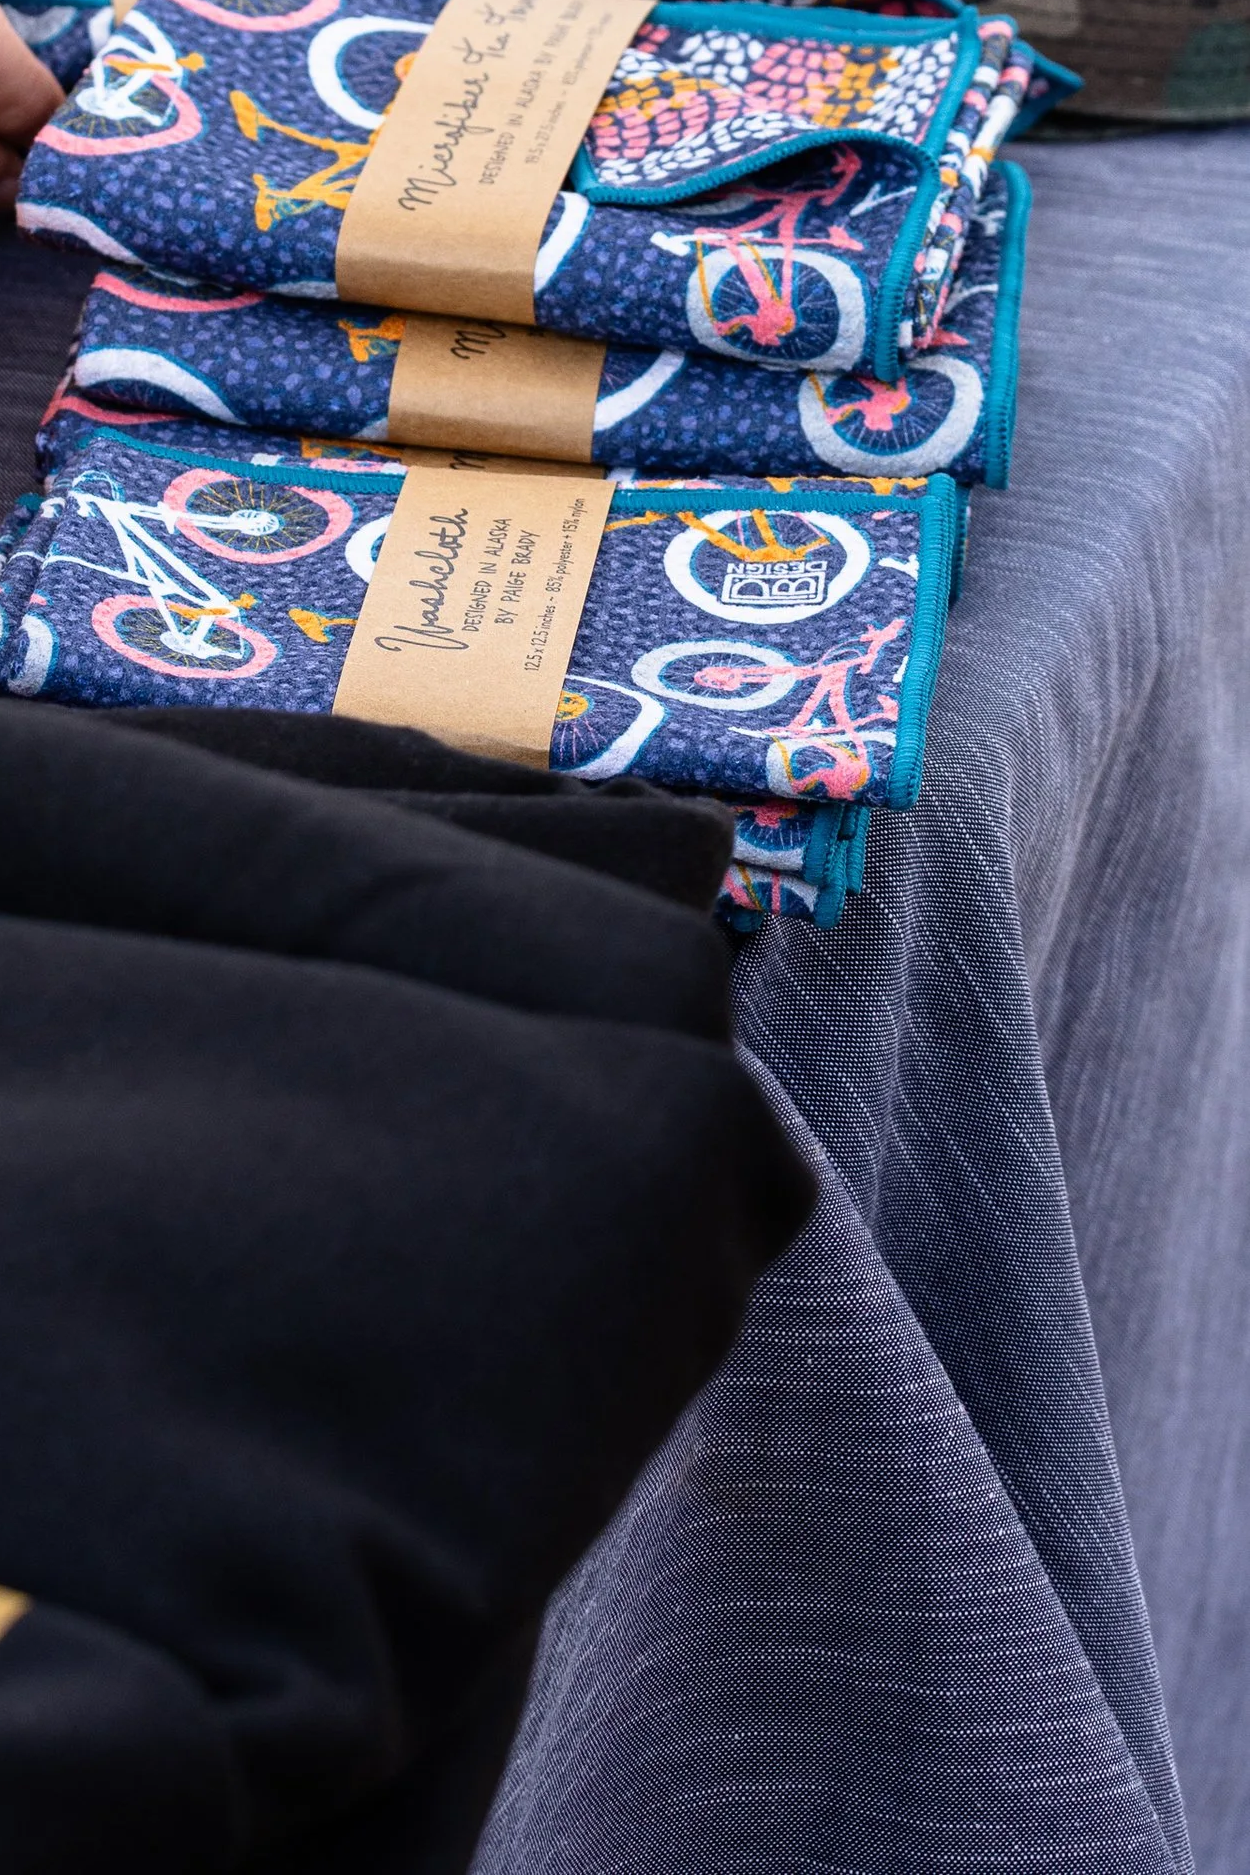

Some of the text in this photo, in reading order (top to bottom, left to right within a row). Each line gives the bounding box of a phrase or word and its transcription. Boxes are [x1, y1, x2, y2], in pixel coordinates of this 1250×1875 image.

[398, 73, 495, 212] Microfiber
[479, 130, 516, 186] DESIGNED
[509, 113, 524, 128] IN
[567, 498, 588, 518] nylon
[561, 518, 580, 533] 15%
[552, 540, 575, 575] polyester
[726, 560, 828, 575] DESIGN
[374, 507, 469, 653] Washcloth
[461, 517, 514, 633] DESIGNED IN ALASKA
[494, 529, 542, 625] BY PAIGE BRADY
[545, 575, 564, 593] 85%
[535, 605, 557, 630] inches
[530, 630, 549, 646] 12.5
[523, 654, 543, 672] 12.5
